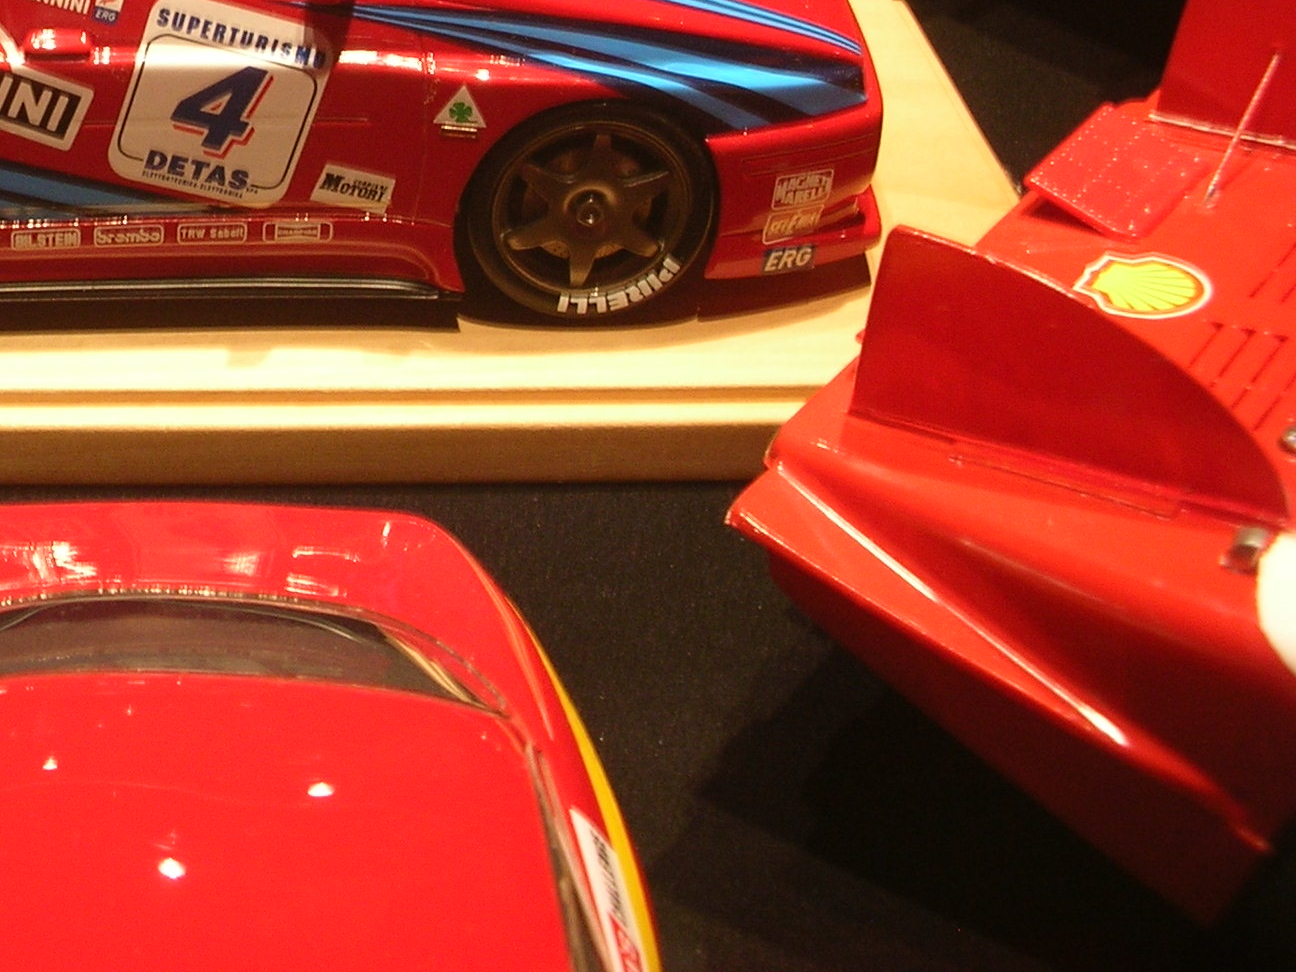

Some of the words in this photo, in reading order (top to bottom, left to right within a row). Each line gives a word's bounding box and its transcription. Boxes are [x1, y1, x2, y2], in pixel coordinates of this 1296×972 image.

[95, 9, 116, 23] ERG
[157, 7, 327, 70] SUPERTURISMO
[170, 65, 274, 159] 4
[144, 149, 250, 190] DETAS
[15, 231, 78, 249] BILSTEIN
[764, 247, 813, 272] ERG
[556, 253, 682, 315] PIRELLI
